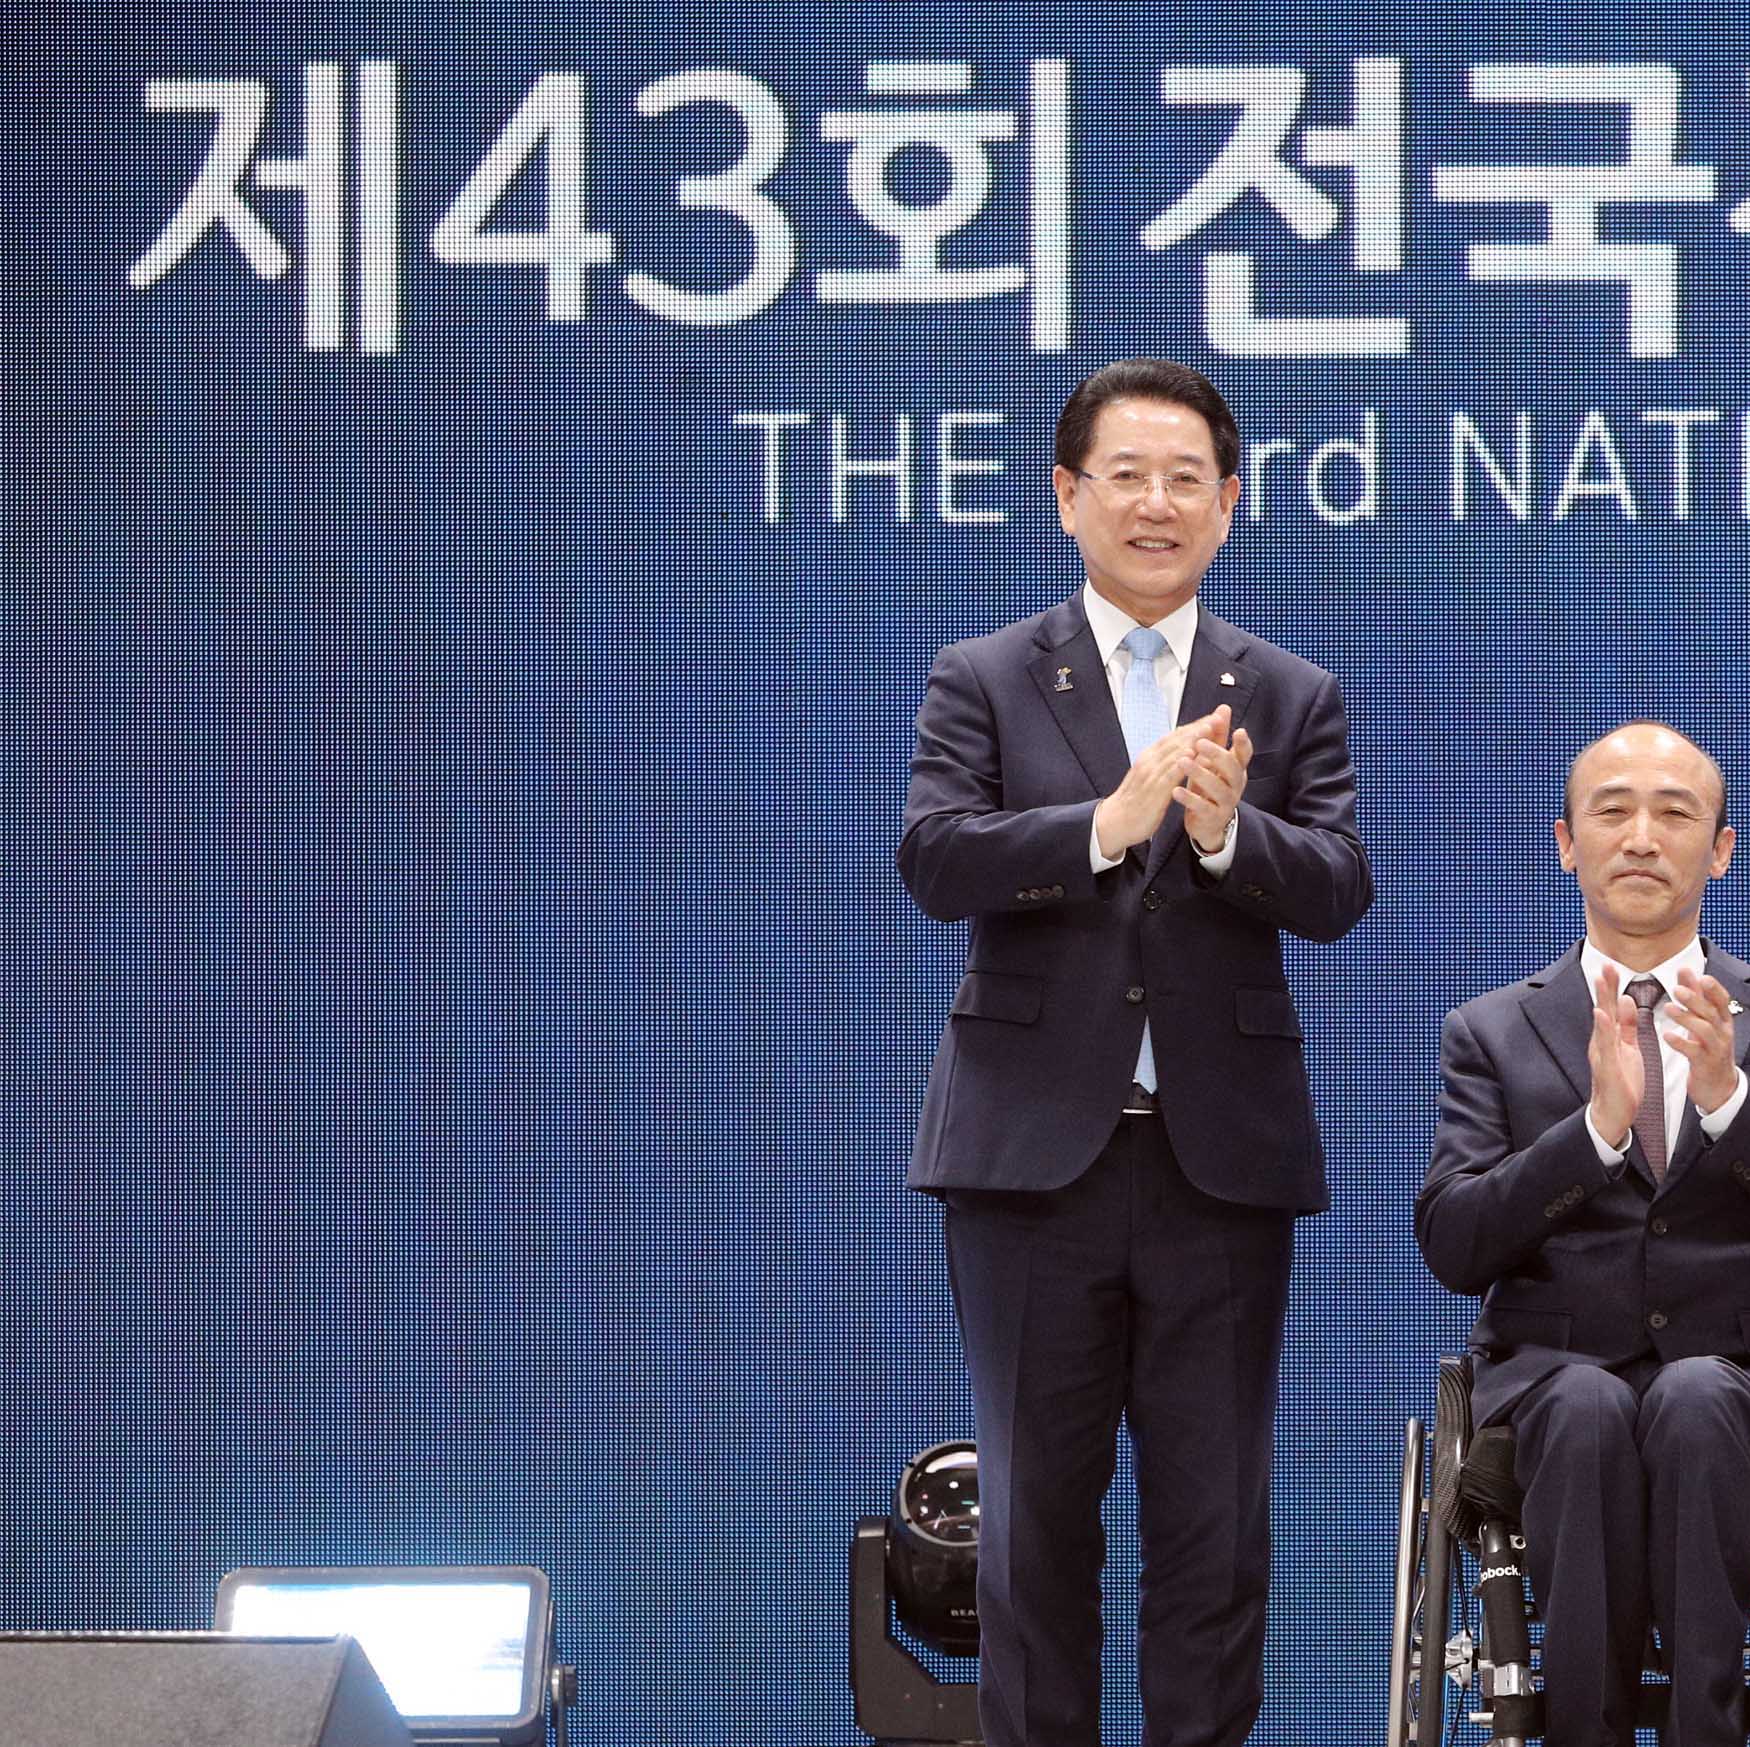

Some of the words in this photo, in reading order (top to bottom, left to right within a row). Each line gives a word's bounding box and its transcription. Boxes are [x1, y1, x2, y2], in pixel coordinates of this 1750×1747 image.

[128, 58, 1071, 355] 제43회
[733, 411, 1006, 524] THE
[1248, 410, 1380, 524] rd
